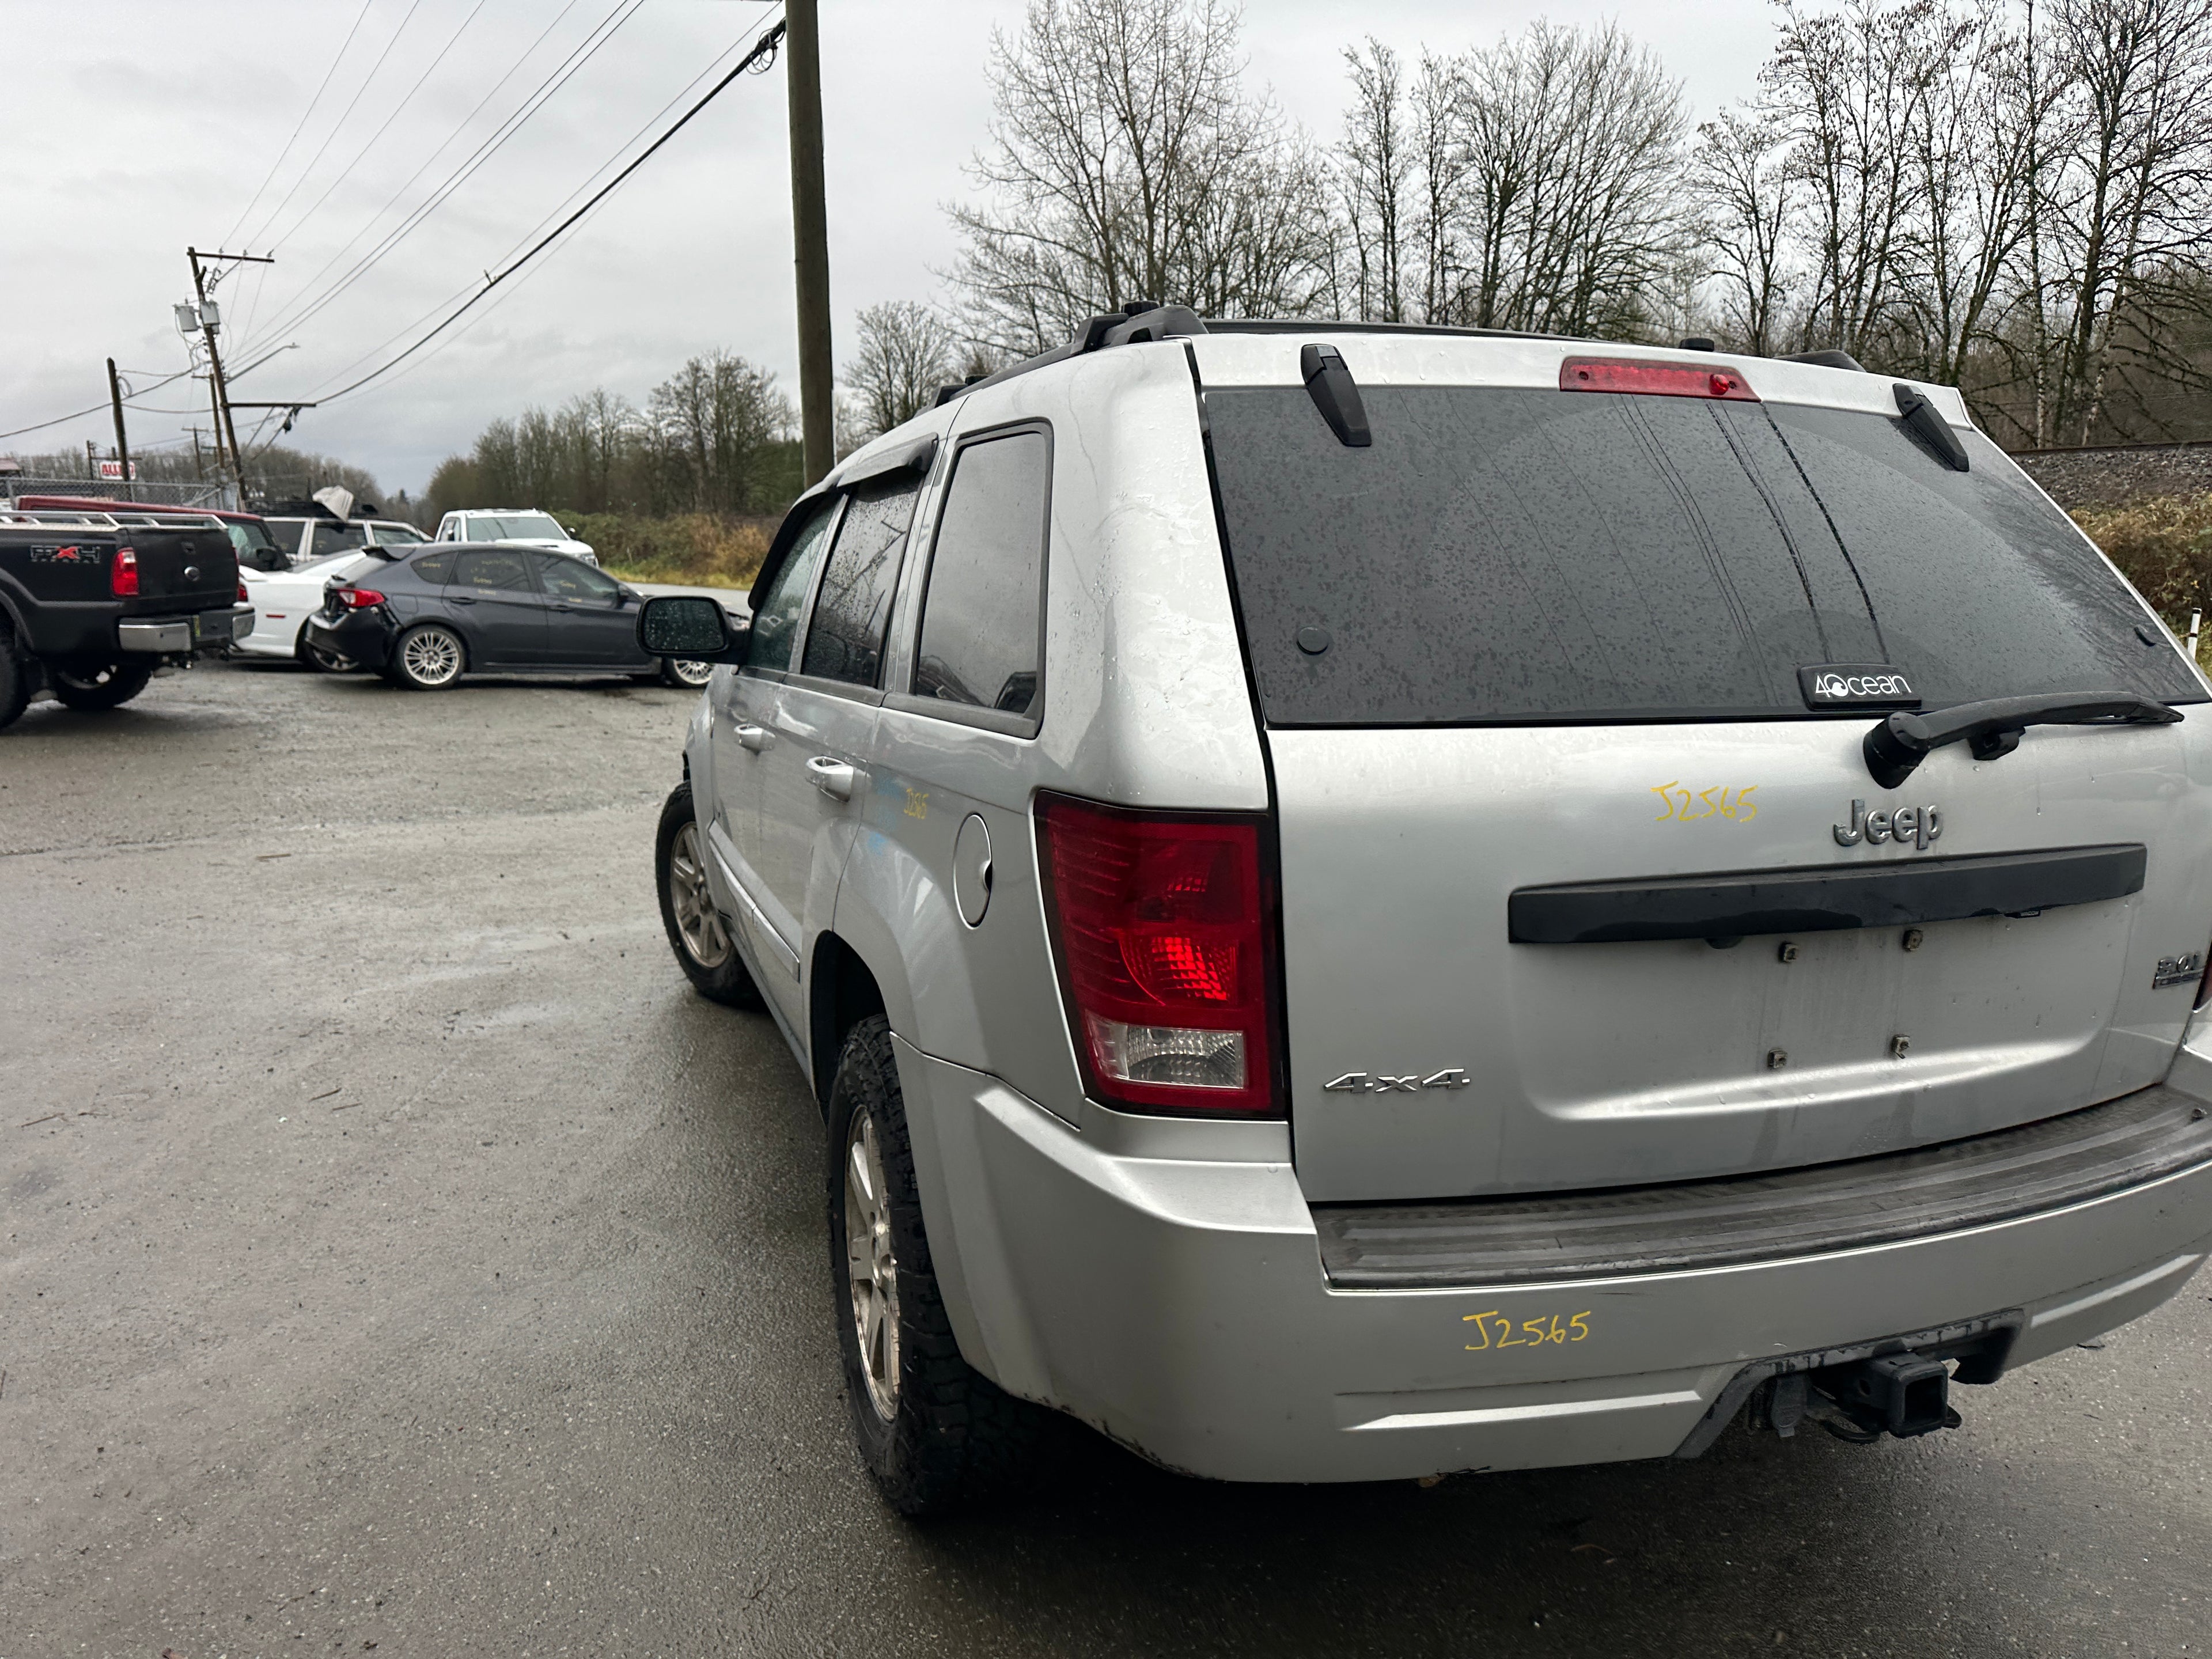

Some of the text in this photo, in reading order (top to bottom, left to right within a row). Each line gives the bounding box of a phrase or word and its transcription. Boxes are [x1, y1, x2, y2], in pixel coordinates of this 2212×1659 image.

[1650, 781, 1758, 823] J2565
[1833, 799, 1944, 850] Jeep
[1324, 1068, 1470, 1093] 4x4
[1463, 1310, 1591, 1350] J2565
